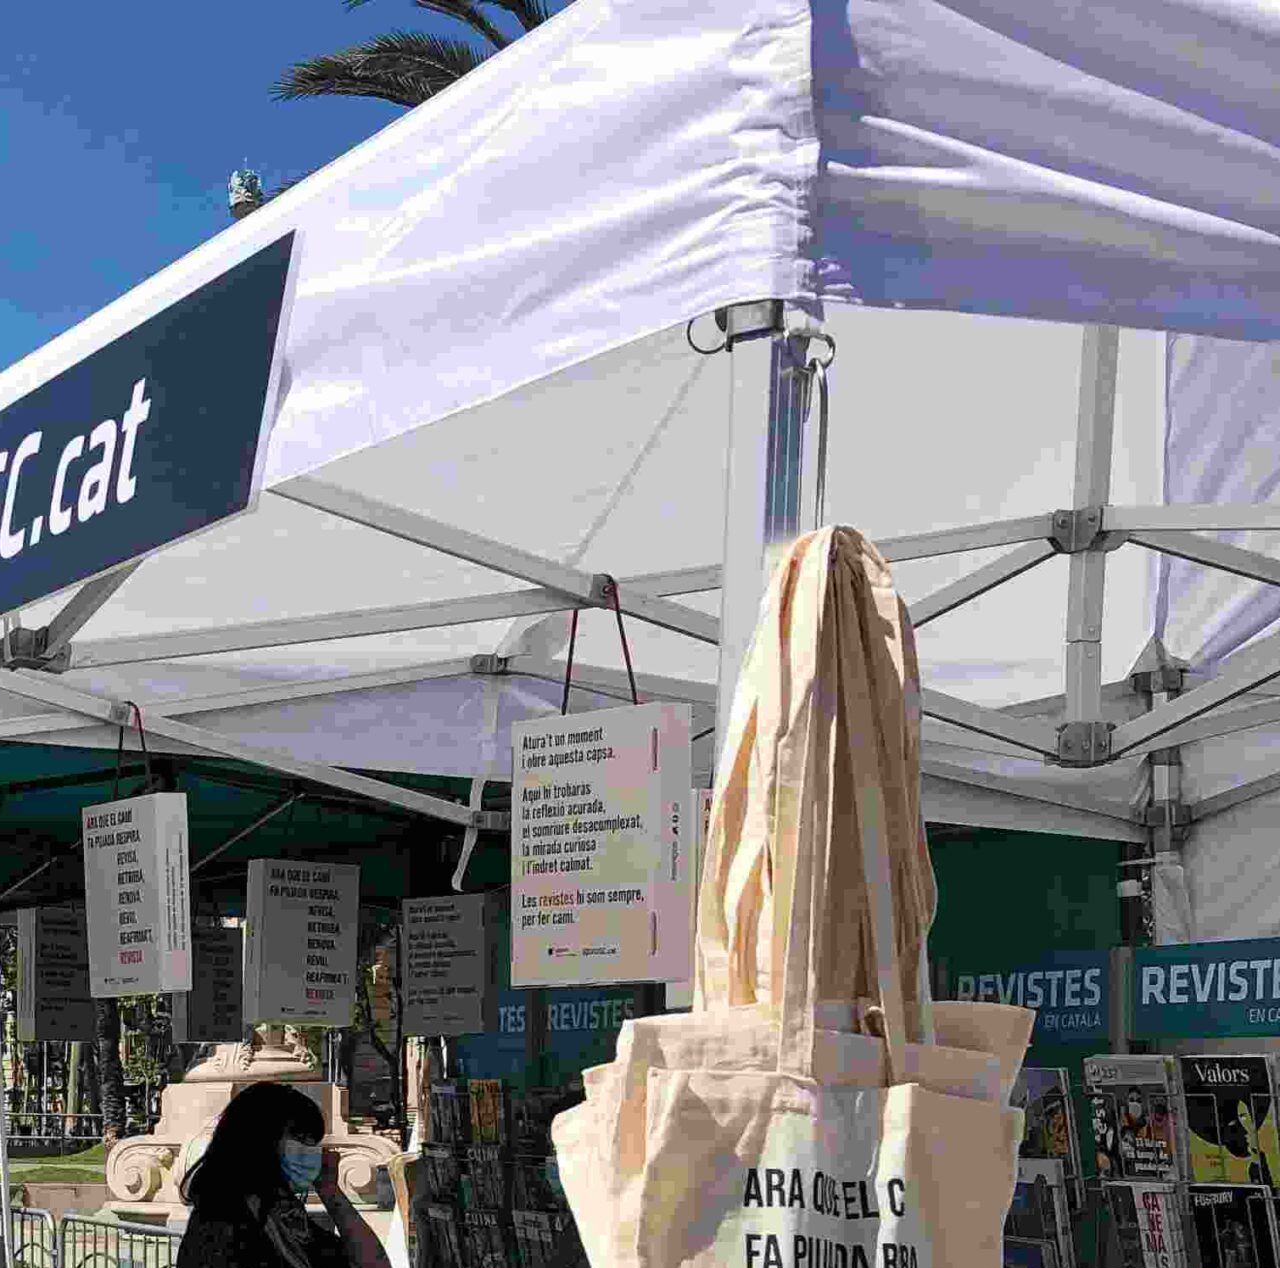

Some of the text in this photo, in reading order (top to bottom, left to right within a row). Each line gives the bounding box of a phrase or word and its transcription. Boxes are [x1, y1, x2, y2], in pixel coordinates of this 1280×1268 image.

[567, 728, 604, 746] moment
[528, 753, 546, 768] obre
[548, 749, 584, 767] aquesta
[532, 821, 570, 837] somriure
[532, 840, 562, 856] mirada
[564, 839, 596, 853] curiosa
[521, 894, 537, 908] Les
[538, 890, 574, 907] revistes
[587, 892, 606, 905] som
[607, 888, 645, 905] sempre,
[521, 915, 536, 930] per
[537, 910, 550, 925] fer
[958, 968, 1101, 1007] REVISTES
[547, 998, 634, 1030] REVISTES
[1044, 1015, 1059, 1030] EN
[1249, 1008, 1266, 1023] EN
[1194, 1063, 1250, 1084] Valors
[743, 1168, 806, 1208] ARA
[812, 1171, 841, 1217] QUE
[842, 1180, 880, 1220] EL
